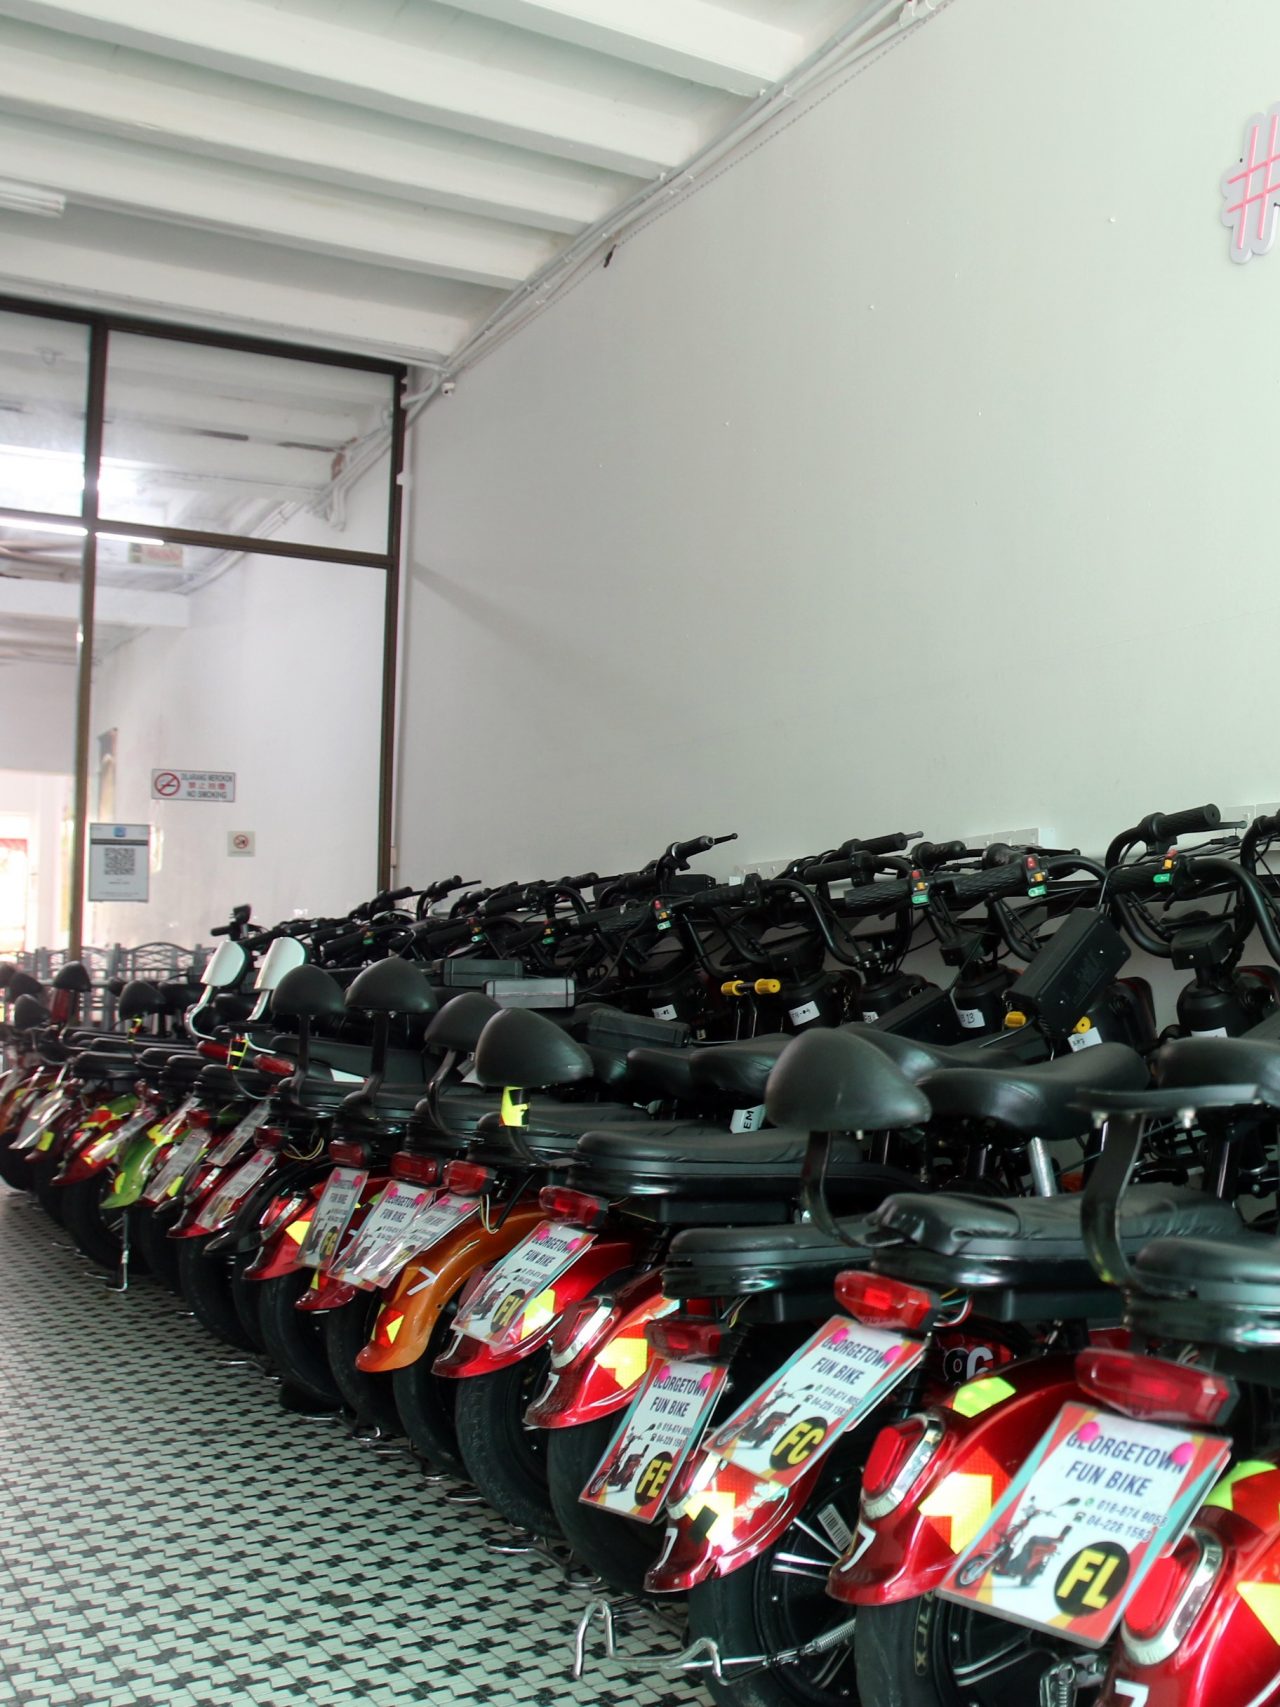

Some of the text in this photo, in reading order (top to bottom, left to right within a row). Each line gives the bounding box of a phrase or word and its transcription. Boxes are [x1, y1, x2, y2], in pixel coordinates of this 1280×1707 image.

[186, 790, 227, 799] NO SMOKING
[811, 1357, 865, 1386] FUN BIKE
[650, 1396, 690, 1418] FUN BIKE
[772, 1422, 825, 1465] FC
[636, 1459, 673, 1499] FE
[1065, 1460, 1154, 1498] FUN BIKE
[1056, 1548, 1121, 1610] FL
